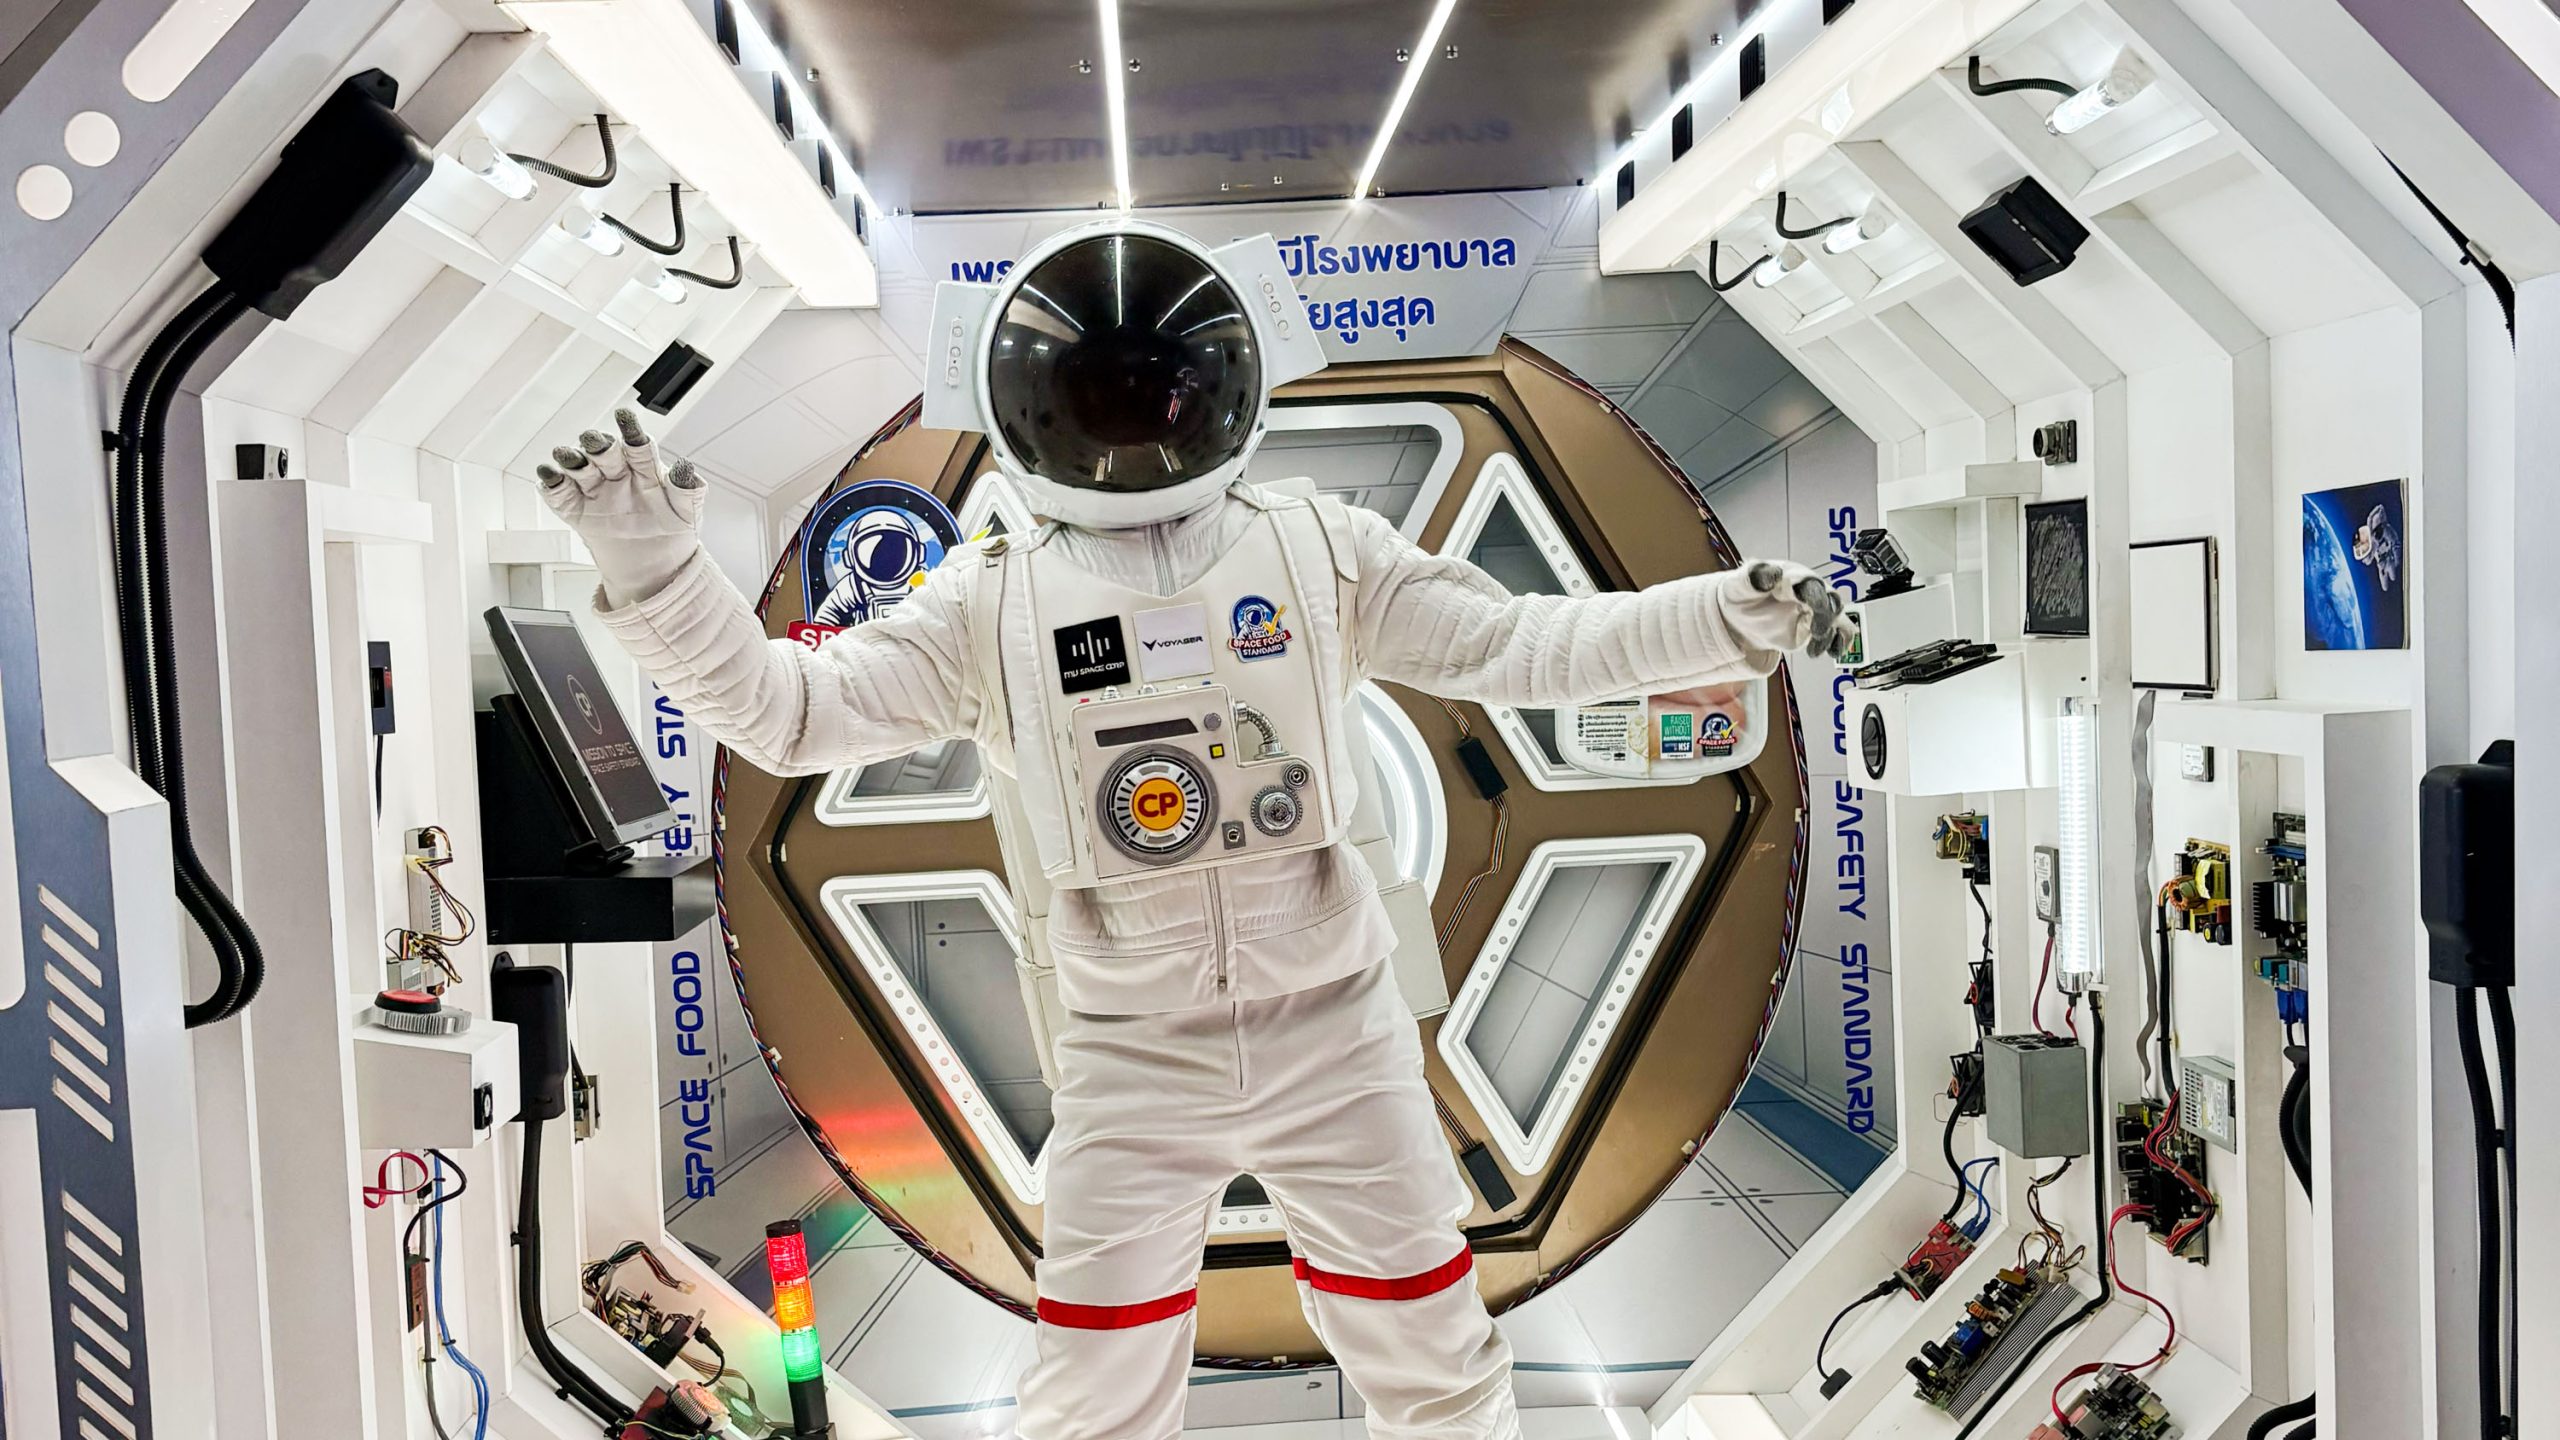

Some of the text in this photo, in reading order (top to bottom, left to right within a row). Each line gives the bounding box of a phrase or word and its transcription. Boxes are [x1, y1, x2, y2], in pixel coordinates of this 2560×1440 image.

[1157, 636, 1203, 648] VOYAGER
[1233, 632, 1287, 648] SPACE FOOD
[1242, 643, 1283, 656] STANDARD
[1137, 791, 1178, 818] CP
[1835, 780, 1867, 921] SAFETY
[671, 951, 706, 1056] FOOD
[1840, 943, 1875, 1134] STANDARD
[680, 1078, 716, 1200] SPACE
